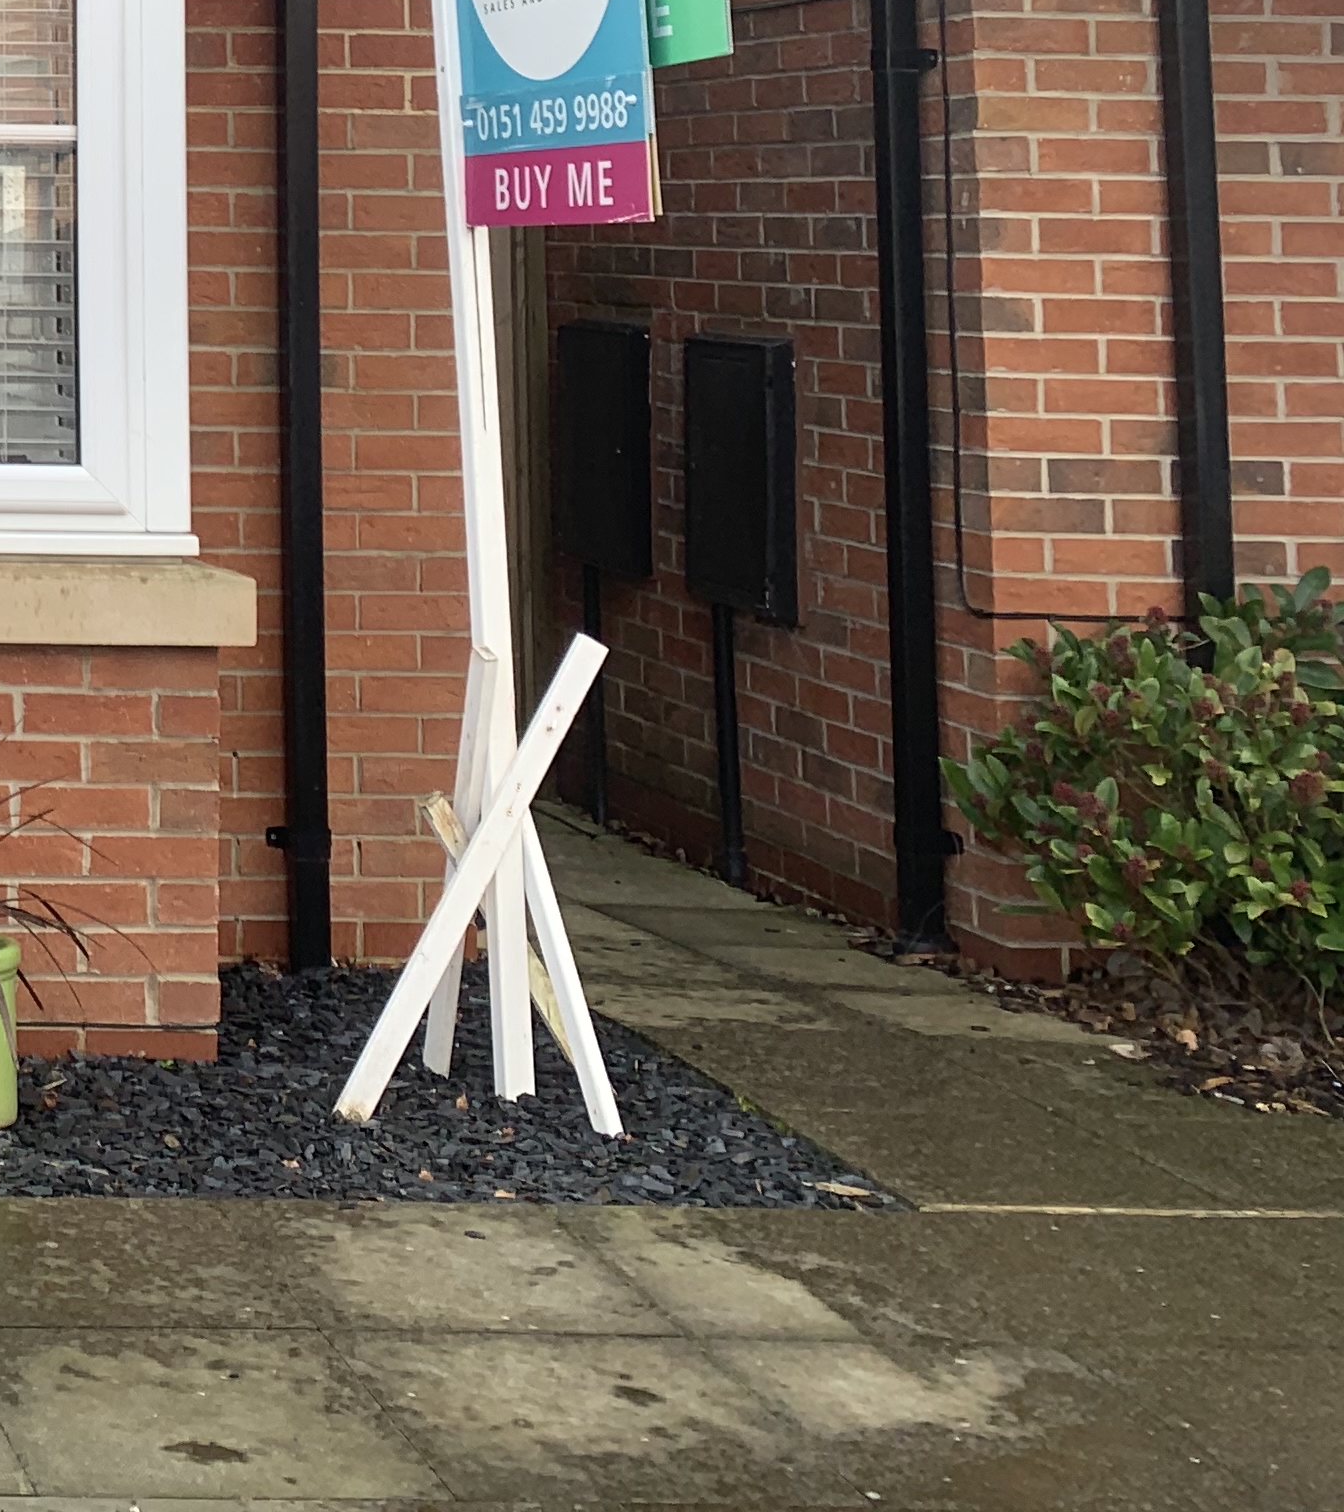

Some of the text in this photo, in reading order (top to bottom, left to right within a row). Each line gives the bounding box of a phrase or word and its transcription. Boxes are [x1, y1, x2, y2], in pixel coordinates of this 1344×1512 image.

[477, 90, 628, 141] 0151 459 9988
[494, 160, 614, 211] BUY ME
